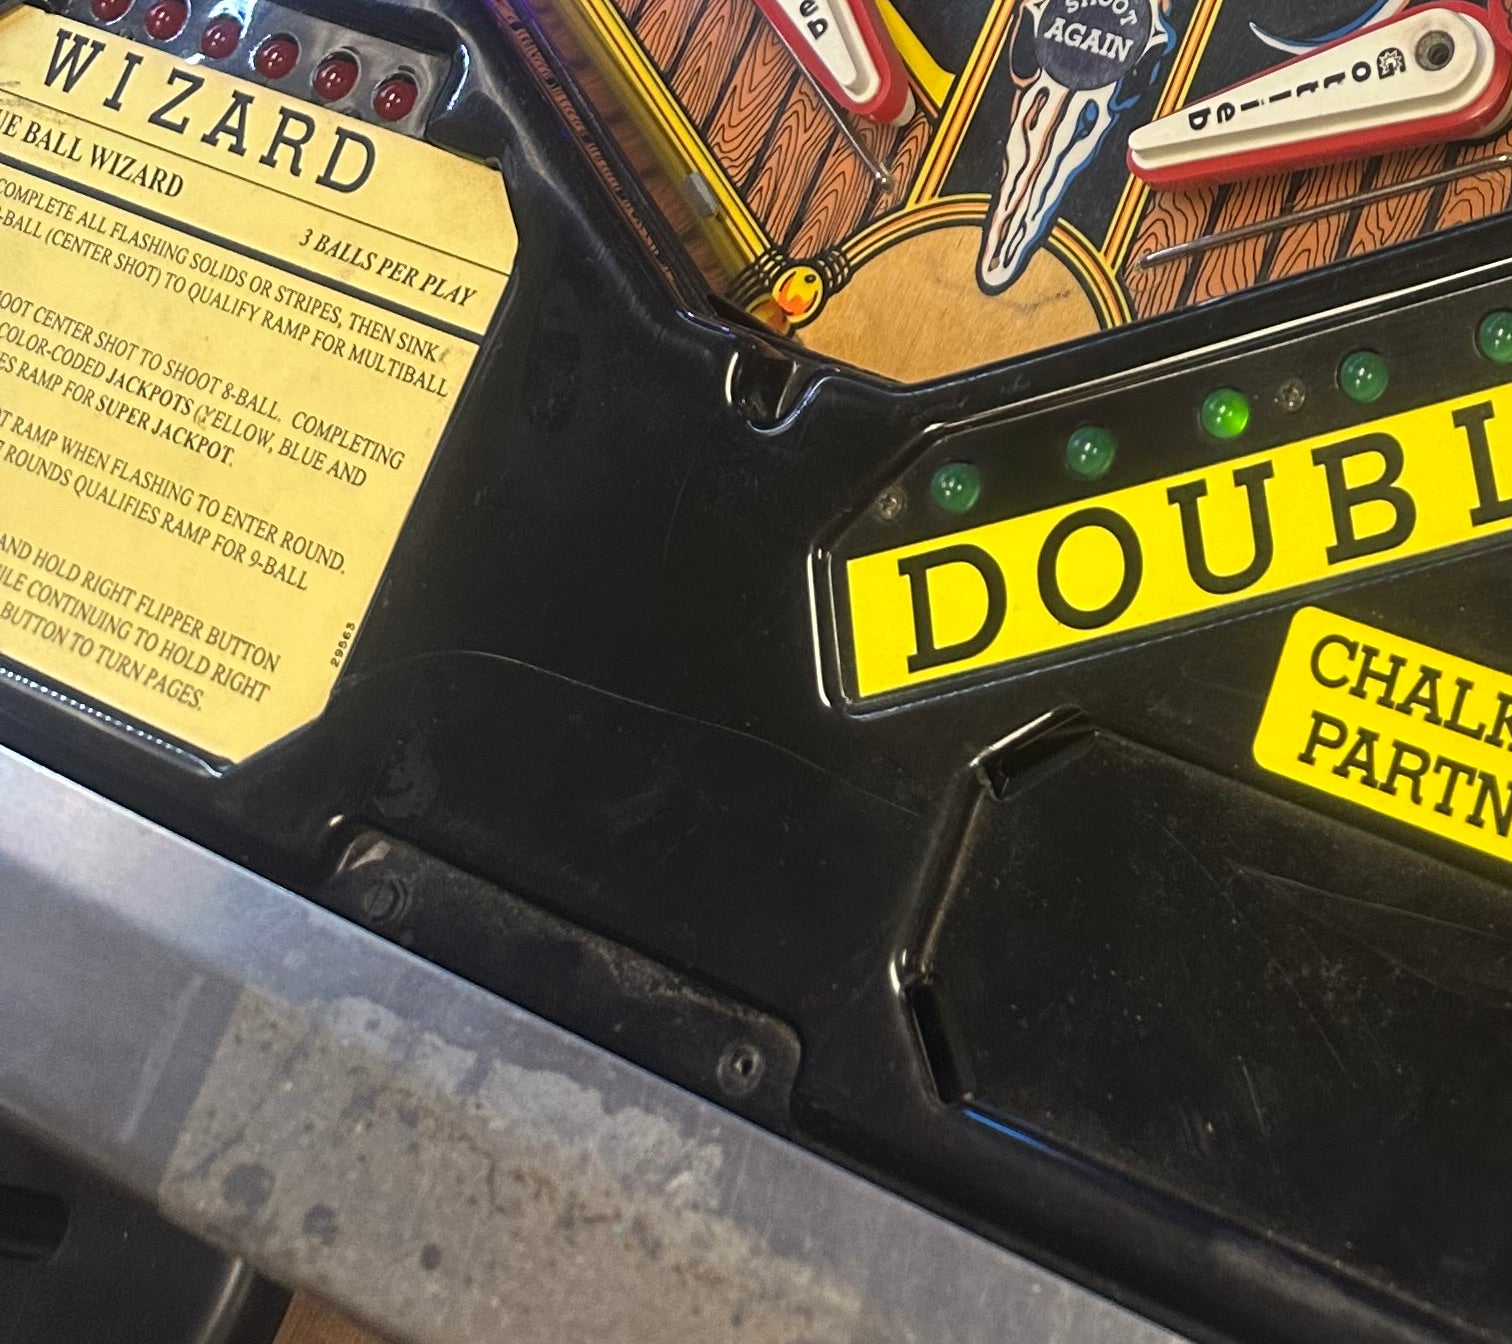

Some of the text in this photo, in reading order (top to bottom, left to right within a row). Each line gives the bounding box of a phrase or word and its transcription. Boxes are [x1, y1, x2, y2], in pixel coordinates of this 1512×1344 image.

[1042, 16, 1135, 63] AGAIN
[23, 120, 83, 162] BALL
[90, 143, 184, 199] WIZARD
[43, 27, 376, 195] WIZARD
[44, 226, 449, 399] (CENTER SHOT) TO QUALIFY RAMP FOR MULTIBALL
[75, 210, 108, 236] ALL
[109, 221, 190, 265] FLASHING
[188, 251, 248, 289] SOLIDS
[249, 275, 273, 299] OR
[274, 284, 343, 329] STRIPES,
[347, 311, 396, 346] THEN
[396, 331, 441, 363] SINK
[313, 233, 478, 308] BALLS PER PLAY
[0, 321, 106, 380] COLOR-CODED
[104, 366, 196, 417] JACKPOTS
[277, 436, 328, 472] BLUE
[325, 458, 368, 488] AND
[16, 360, 64, 393] RAMP
[61, 378, 98, 409] FOR
[94, 393, 152, 431] SUPER
[150, 418, 236, 469] JACKPOT.
[32, 305, 406, 471] CENTER SHOT TO SHOOT 8-BALL. COMPLETING
[3, 442, 309, 593] ROUNDS QUALIFIES RAMP FOR 9-BALL
[10, 415, 59, 449] RAMP
[60, 435, 112, 473] WHEN
[109, 457, 195, 508] FLASHING
[195, 493, 221, 519] TO
[220, 504, 279, 545] ENTER
[279, 530, 346, 575] ROUND.
[0, 600, 205, 712] BUTTON TO TURN PAGES.
[26, 578, 271, 704] CONTINUING TO HOLD RIGHT
[31, 547, 282, 674] HOLD RIGHT FLIPPER BUTTON
